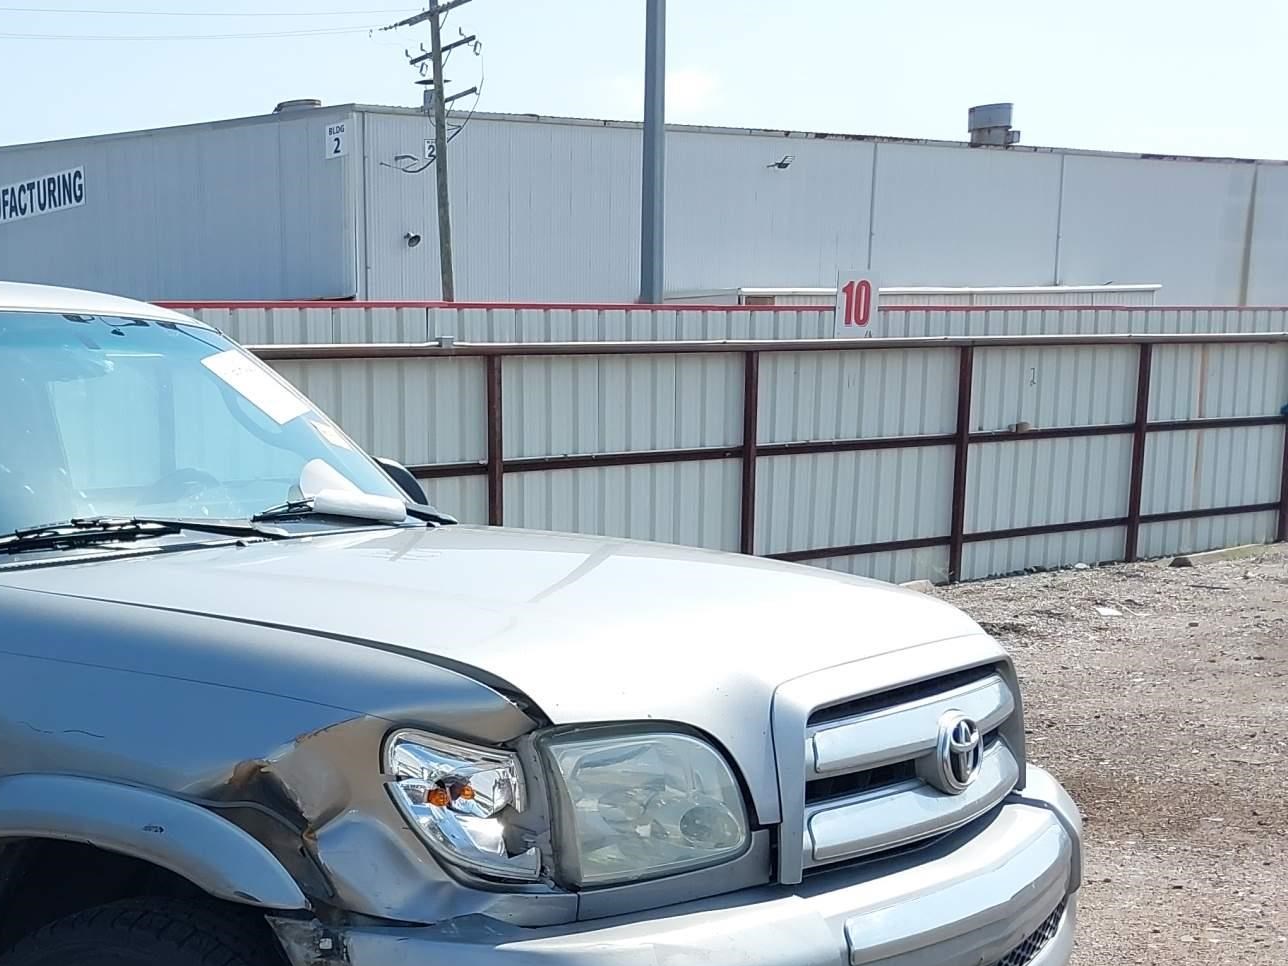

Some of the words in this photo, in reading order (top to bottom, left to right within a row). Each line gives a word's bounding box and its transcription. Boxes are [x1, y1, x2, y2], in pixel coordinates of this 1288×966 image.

[329, 124, 345, 136] BLDG
[333, 137, 341, 154] 2
[842, 280, 871, 326] 10
